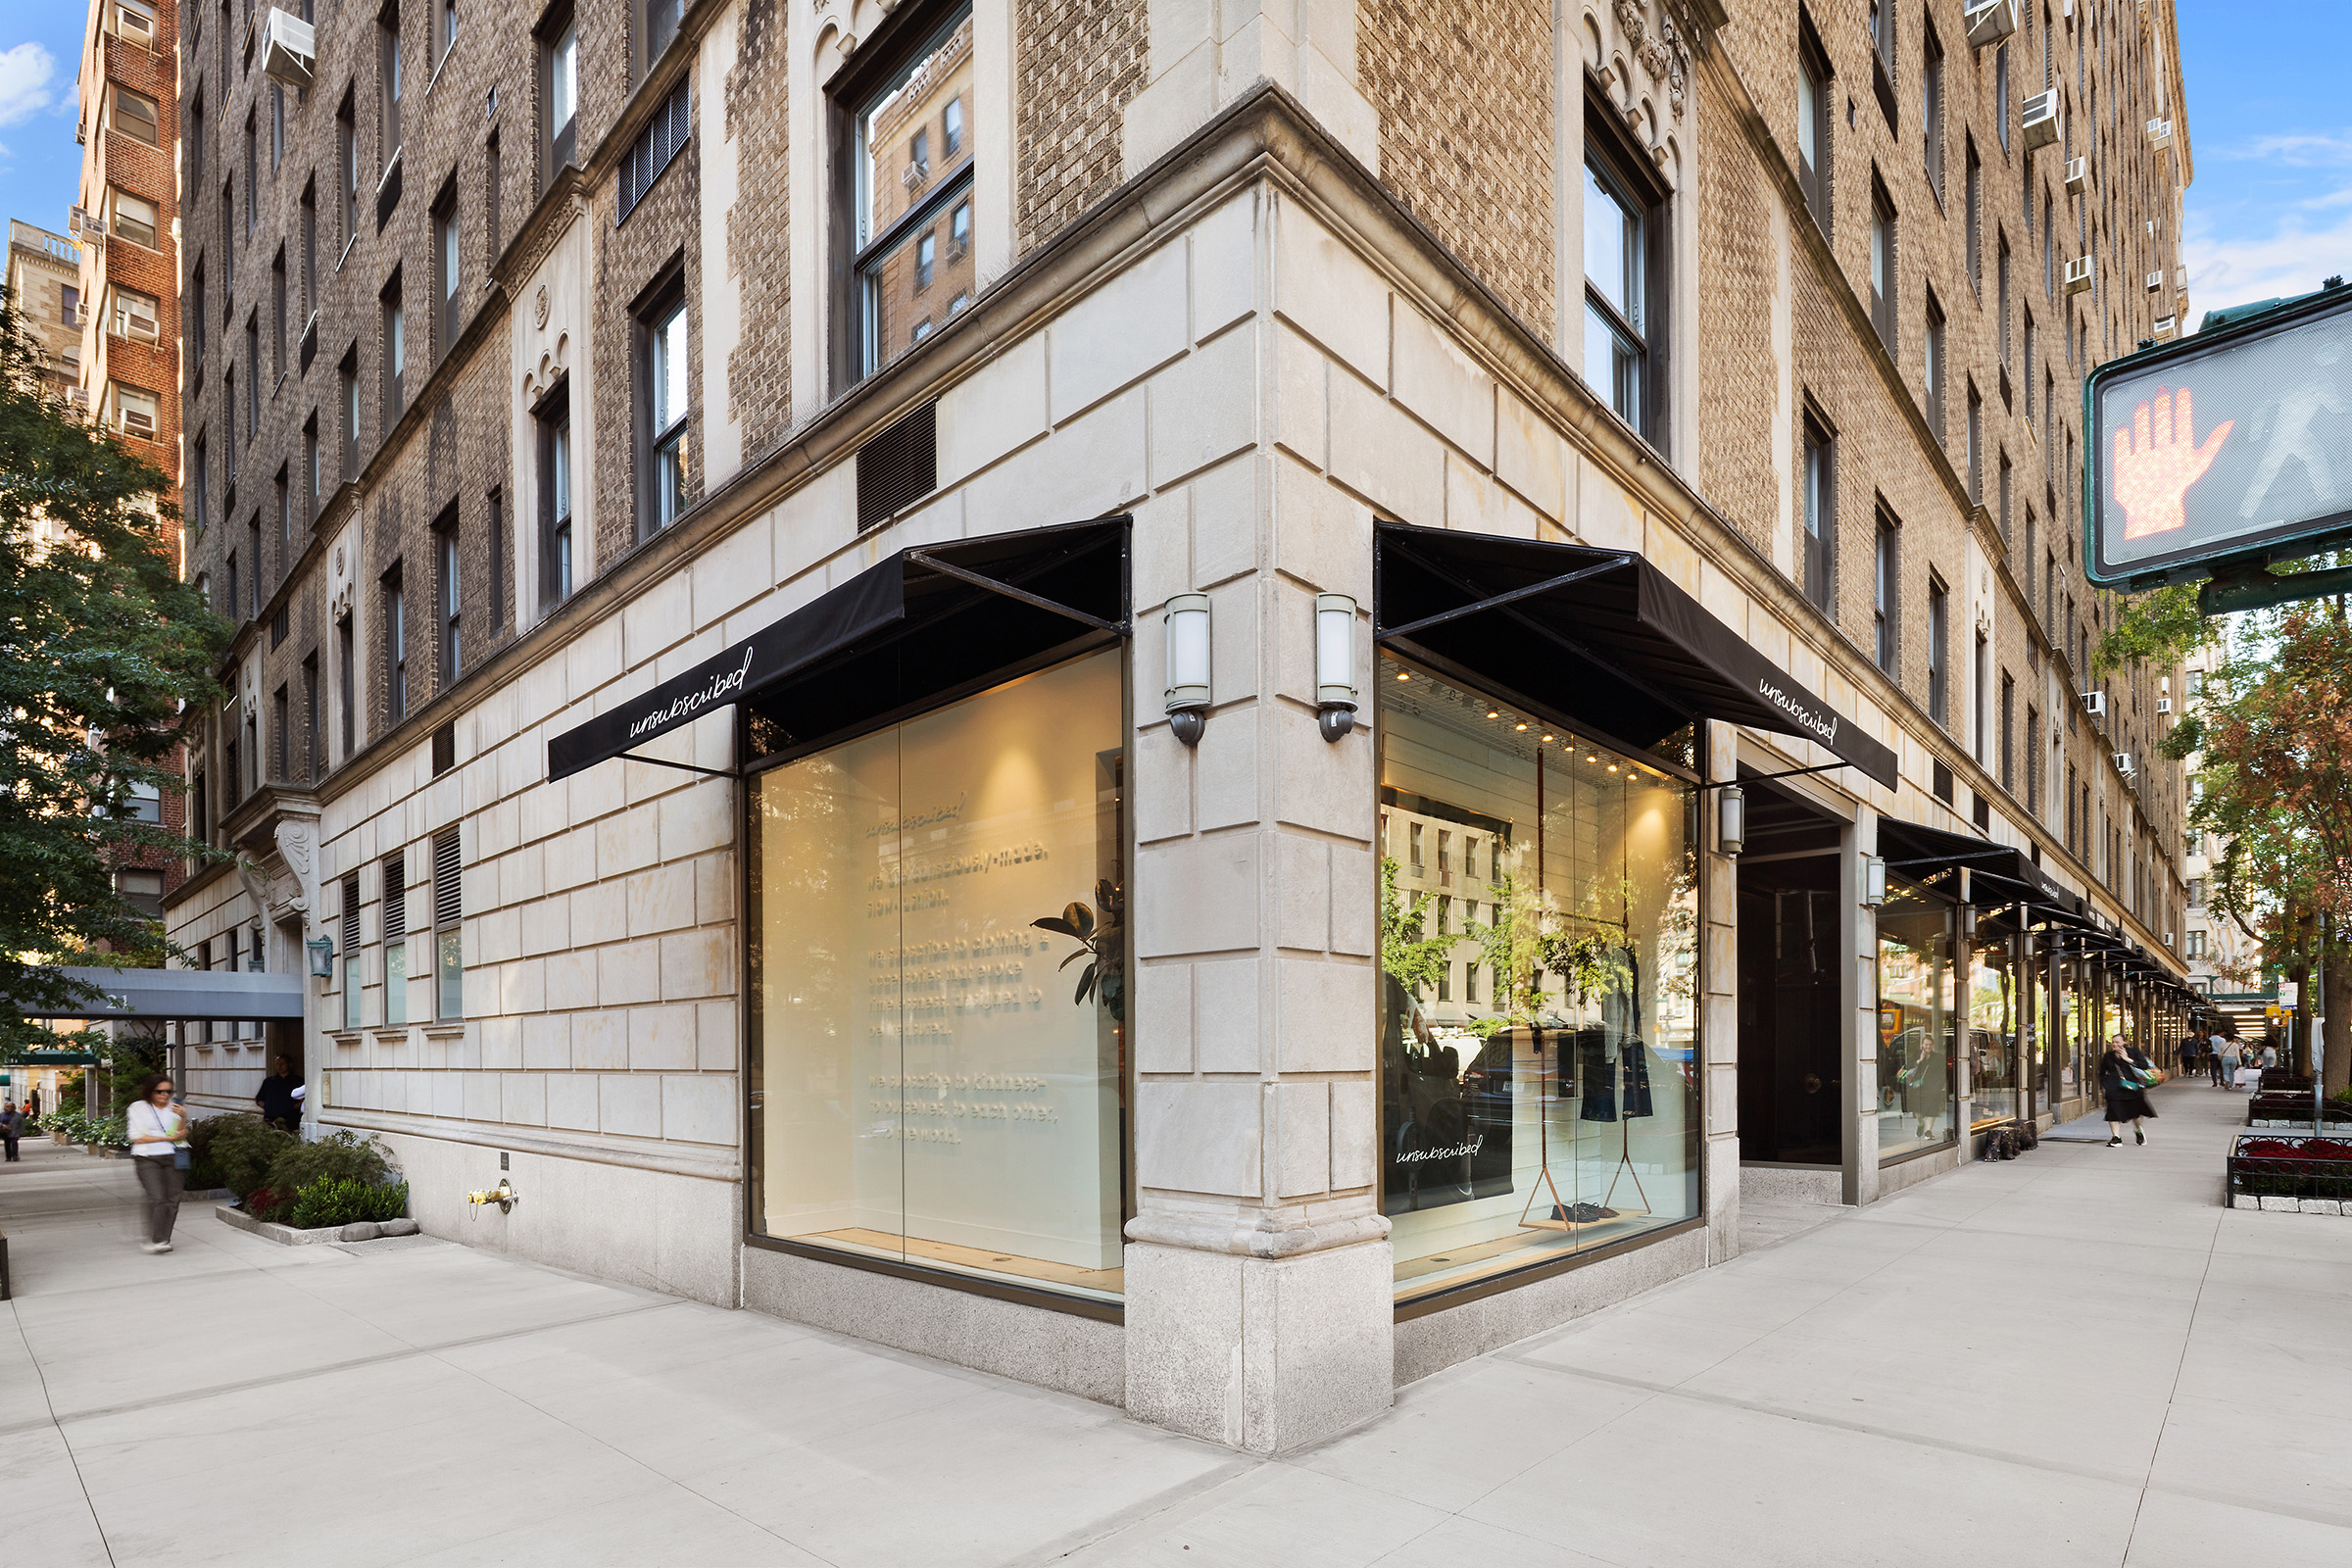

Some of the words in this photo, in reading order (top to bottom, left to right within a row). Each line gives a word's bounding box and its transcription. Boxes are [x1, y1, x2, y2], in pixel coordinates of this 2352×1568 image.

[630, 646, 754, 739] unsubscribed
[1759, 678, 1838, 746] unsubscribed
[867, 888, 950, 918] slow-ashion.
[972, 930, 1032, 956] clothing
[868, 967, 942, 990] accesories
[105, 994, 128, 1009] 21
[971, 1102, 1005, 1120] each
[1396, 1134, 1484, 1163] unsubscribed
